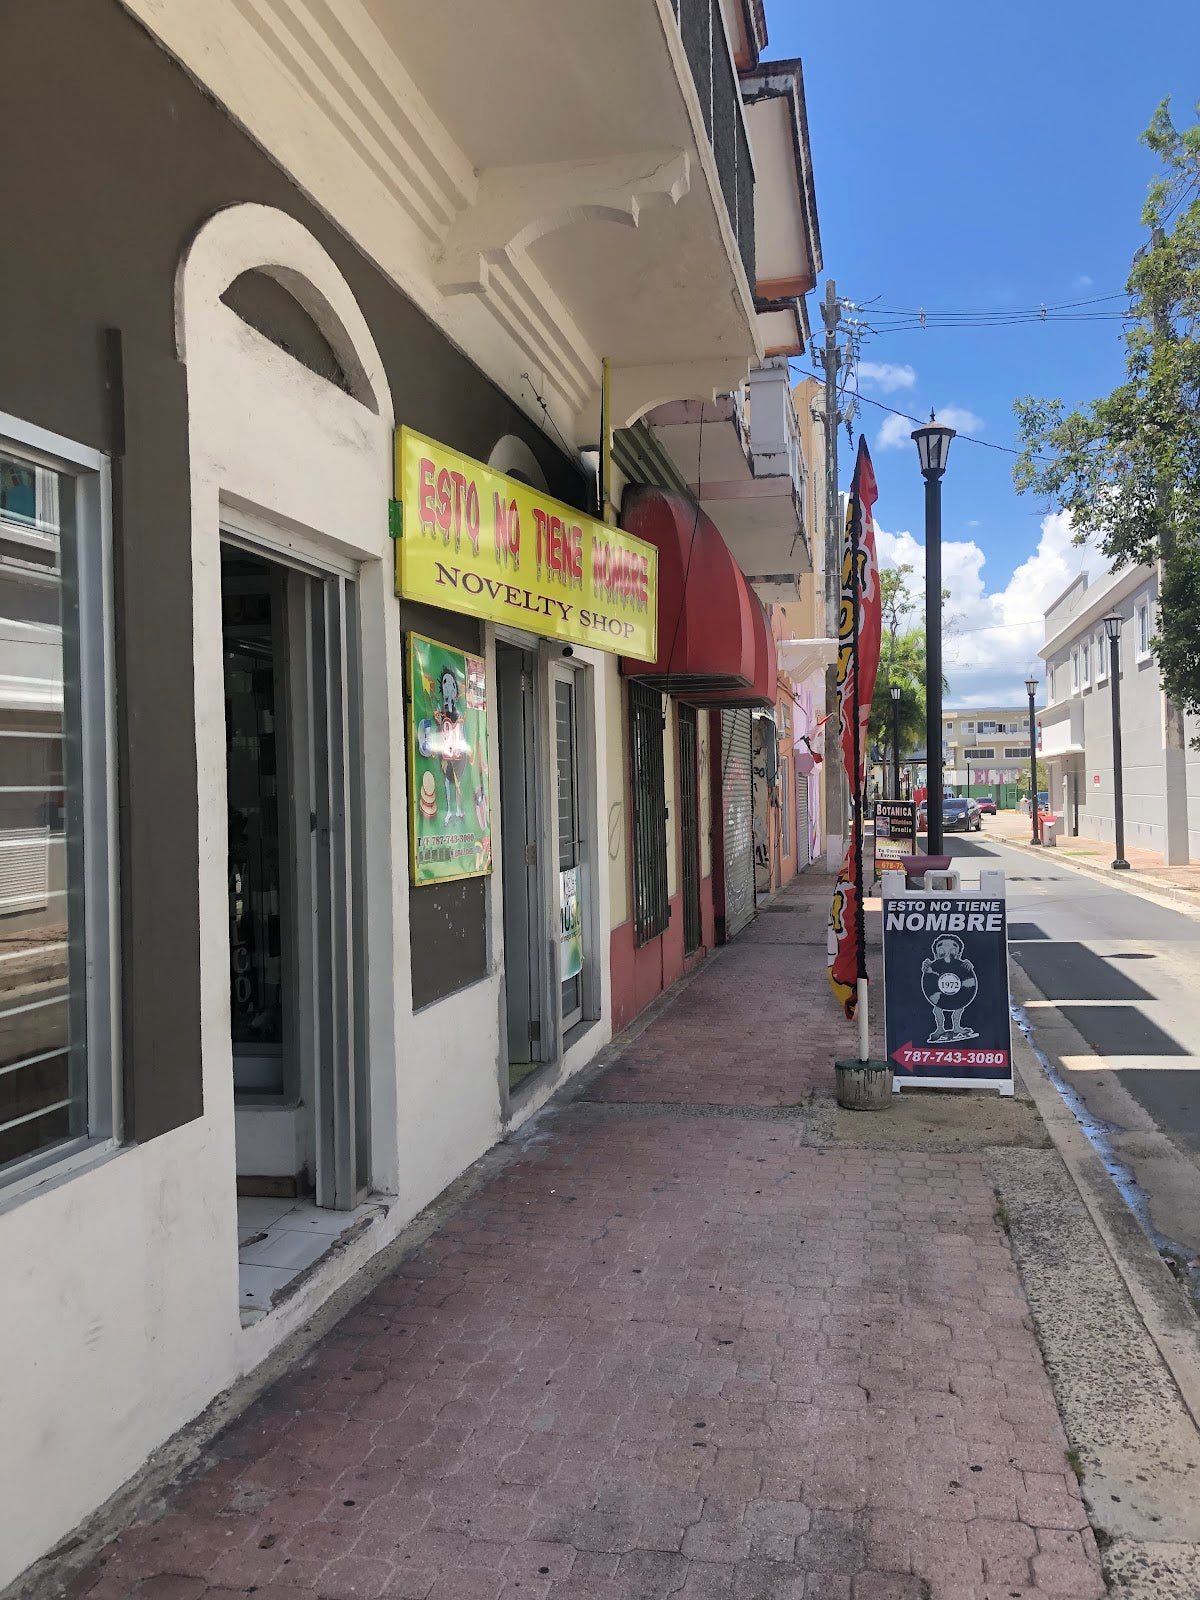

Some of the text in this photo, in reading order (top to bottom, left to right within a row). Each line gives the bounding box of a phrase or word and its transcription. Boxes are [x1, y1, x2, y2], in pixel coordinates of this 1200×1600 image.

[419, 457, 480, 557] ESTO
[493, 491, 521, 572] NO
[532, 508, 583, 593] TIENE
[434, 561, 635, 640] NOVELTY SHOP
[876, 804, 913, 817] BOTANICA
[888, 901, 1000, 912] ESTO NO TIENE
[886, 913, 1003, 932] NOMBRE
[941, 980, 959, 989] 1972
[903, 1050, 1004, 1064] 787-743-3080
